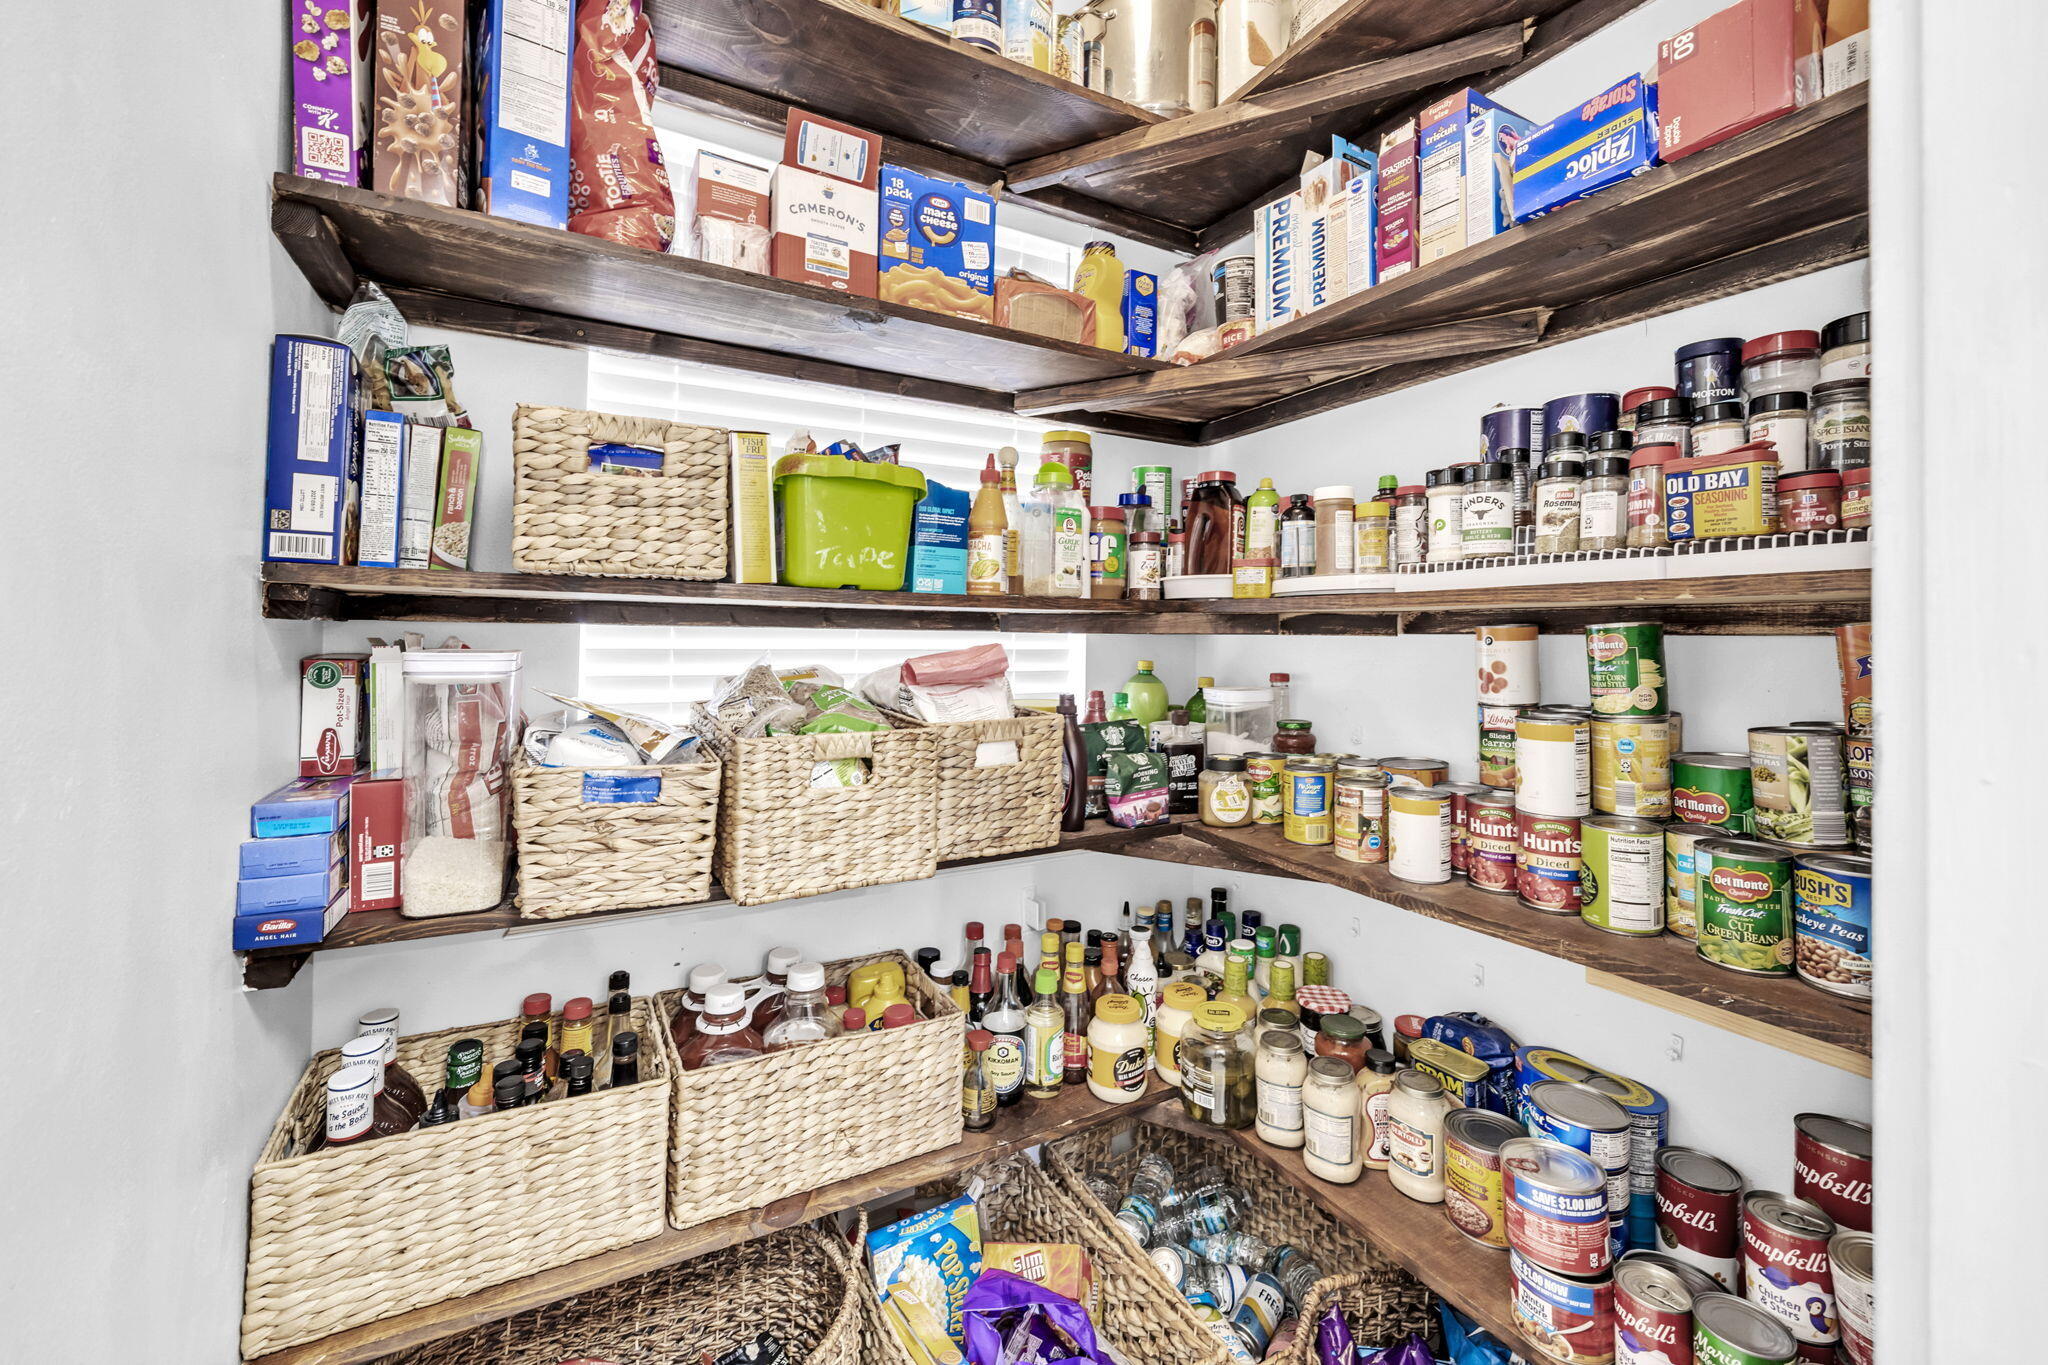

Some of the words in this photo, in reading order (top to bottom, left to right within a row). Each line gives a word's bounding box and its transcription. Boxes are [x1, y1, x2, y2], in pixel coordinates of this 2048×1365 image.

[1673, 31, 1695, 61] 80
[302, 103, 334, 115] CONNECT
[1428, 99, 1453, 116] family
[1581, 79, 1637, 122] Storage
[1433, 109, 1449, 120] size
[1425, 123, 1458, 146] triscuit
[1597, 115, 1635, 140] SLIDER
[1664, 124, 1673, 149] Zipper
[1673, 115, 1681, 145] Double
[1563, 135, 1631, 180] Ziploc
[890, 176, 905, 190] 18
[885, 185, 913, 200] pack
[789, 202, 866, 233] CAMERON'S
[1272, 197, 1292, 318] PREMIUM
[1312, 216, 1327, 307] PREMIUM
[958, 270, 989, 284] original
[1223, 332, 1243, 345] RICE
[1692, 387, 1735, 399] MORTON
[1815, 427, 1841, 438] SPICE
[741, 437, 764, 447] FISH
[745, 445, 761, 454] FRI
[1820, 441, 1851, 451] POPPY
[1666, 478, 1700, 495] OLD
[1705, 470, 1743, 490] BAY
[447, 496, 457, 515] ranch
[455, 488, 464, 510] bacon
[1462, 495, 1506, 512] KINDER'S
[1694, 488, 1748, 506] SEASONING
[1058, 537, 1080, 545] GARLIC
[1606, 673, 1627, 681] CORN
[1608, 680, 1627, 688] STYLE
[335, 687, 346, 729] Pot-Sized
[1488, 713, 1514, 725] Libby's
[1489, 732, 1512, 740] Sliced
[318, 731, 335, 772] Luxury
[469, 741, 480, 767] Arroz
[1763, 759, 1781, 767] PEAS
[1133, 768, 1159, 778] MORNING
[1674, 796, 1687, 808] Del
[1687, 800, 1725, 814] Monte
[1684, 811, 1707, 821] Quality
[1480, 840, 1511, 851] Diced
[1536, 857, 1570, 869] Diced
[1714, 874, 1731, 887] Del
[1731, 878, 1769, 892] Monte
[1795, 873, 1848, 904] BUSH'S
[1704, 893, 1726, 903] MADE
[1728, 889, 1753, 898] Quality
[1805, 893, 1822, 903] BEST
[262, 922, 294, 932] Barilla
[1706, 922, 1742, 941] GREEN
[1744, 931, 1780, 945] BEANS
[1728, 919, 1755, 933] CUT
[1828, 924, 1865, 943] Peas
[255, 934, 278, 942] ANGEL
[1130, 972, 1154, 983] Chosen
[987, 1055, 1019, 1065] KIKKOMAN
[1414, 1063, 1464, 1100] SPAM
[329, 1113, 340, 1122] The
[341, 1102, 366, 1119] Sauce
[334, 1122, 347, 1131] the
[348, 1107, 370, 1127] Boss!
[1531, 1189, 1557, 1208] SAVE
[1558, 1196, 1585, 1211] $1.00
[1585, 1195, 1602, 1211] NOW
[1743, 1220, 1828, 1273] Campbell's
[1013, 1251, 1044, 1271] slim
[1523, 1261, 1544, 1286] $1.00
[1544, 1277, 1569, 1298] NOW
[1520, 1294, 1549, 1320] Moore
[1522, 1287, 1546, 1313] Dinty
[1757, 1284, 1802, 1313] Chicken
[1759, 1296, 1768, 1306] &
[1769, 1300, 1801, 1322] Stars
